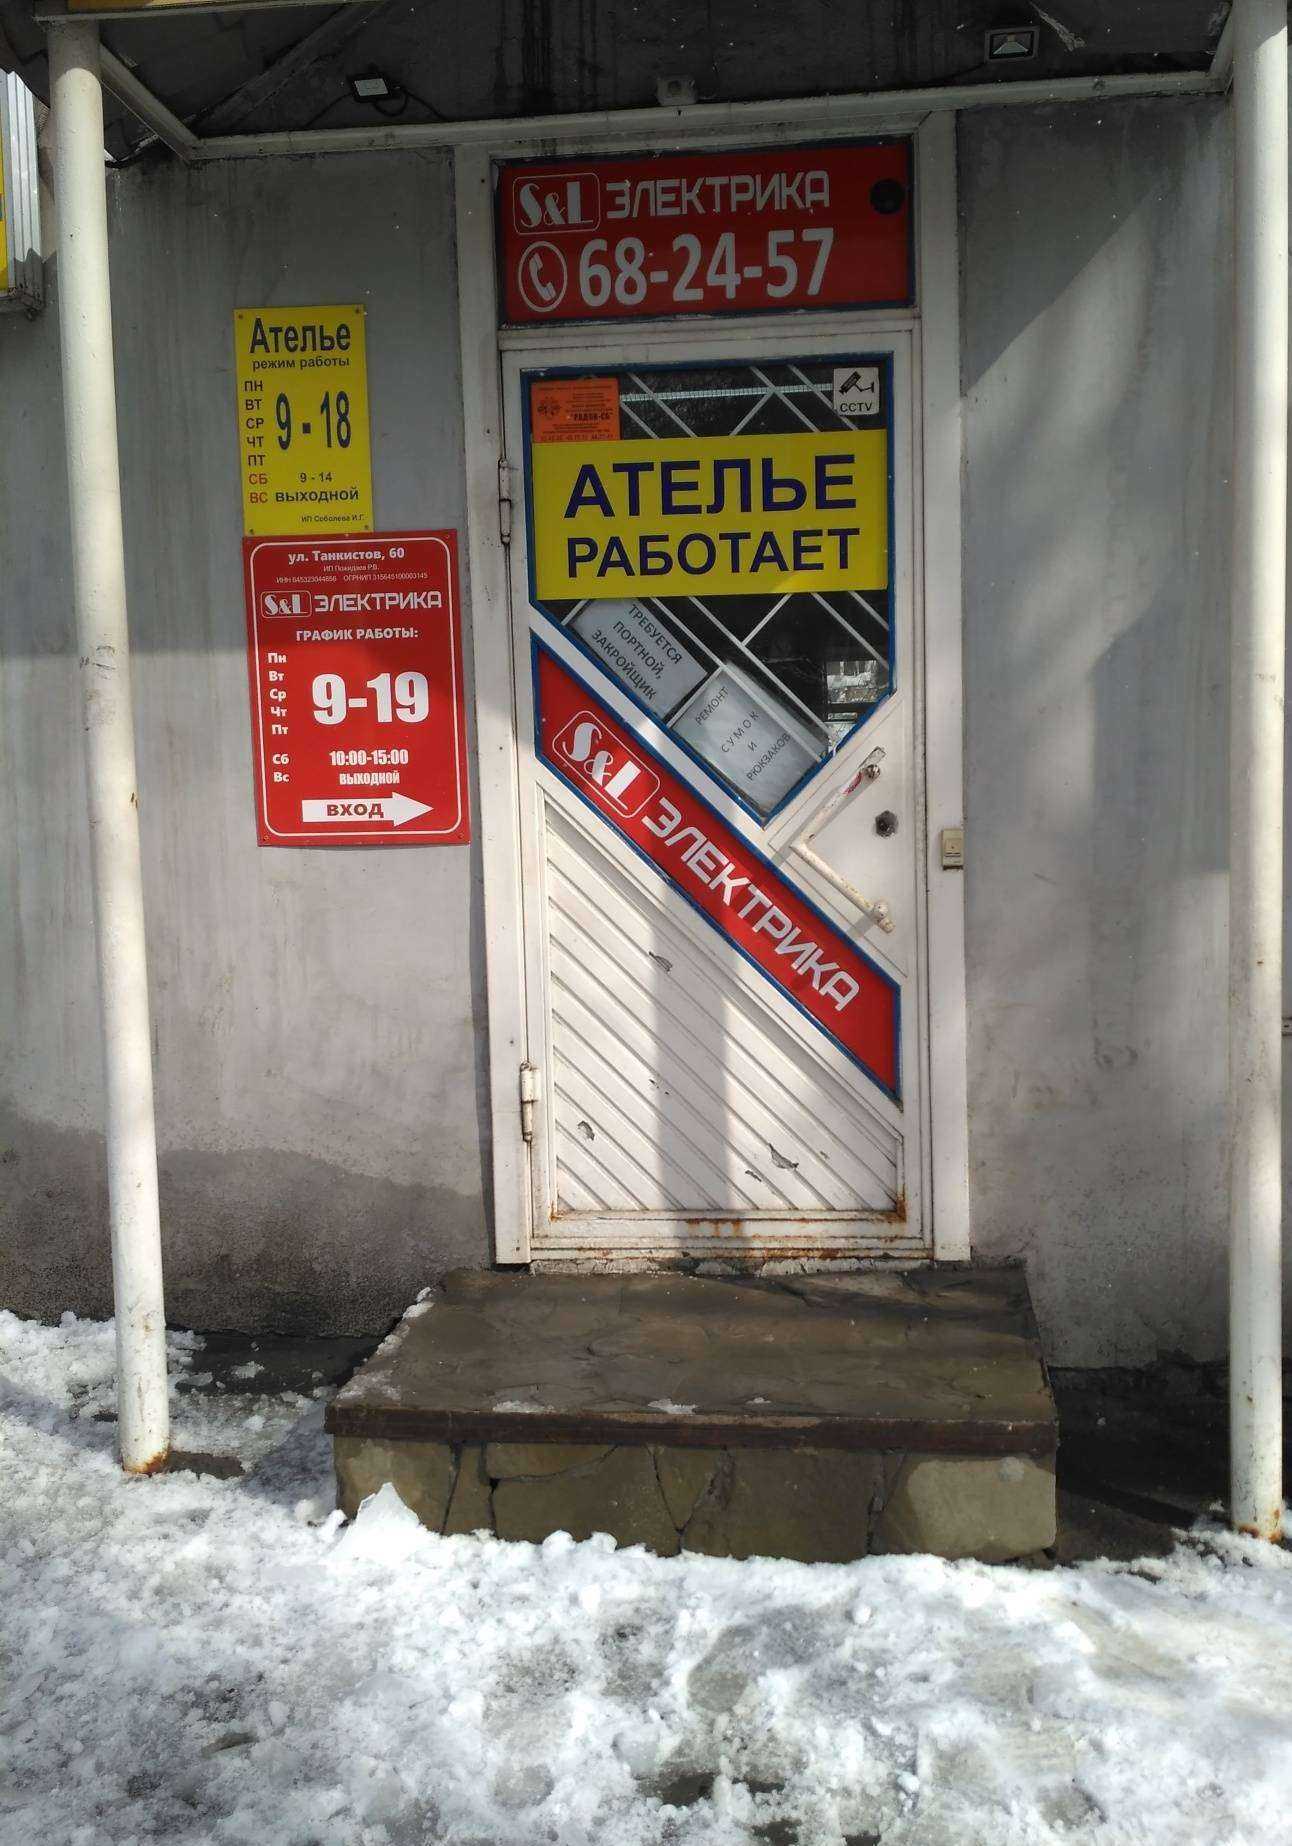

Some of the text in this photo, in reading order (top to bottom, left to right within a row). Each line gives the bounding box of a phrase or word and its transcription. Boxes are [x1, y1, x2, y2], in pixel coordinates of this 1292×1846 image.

[605, 170, 831, 219] ЭЛЕКТРИКА
[578, 227, 834, 307] 68-24-57
[250, 317, 351, 354] Ателье
[252, 356, 349, 371] режим работы
[244, 381, 263, 392] ПН
[245, 399, 262, 410] ВТ
[840, 401, 872, 413] CCTV
[246, 418, 264, 429] СР
[247, 436, 264, 448] ЧТ
[248, 455, 265, 466] ПТ
[249, 473, 268, 485] СБ
[563, 454, 857, 519] АТЕЛЬЕ
[250, 492, 268, 504] ВС
[288, 547, 405, 565] ул. Танкистов, 60
[566, 527, 860, 579] РАБОТАЕТ
[314, 591, 442, 612] ЭЛЕКТРИКА
[296, 627, 419, 642] ГРАФИК РАБОТЫ:
[628, 604, 682, 664] ТРЕБУЕТСЯ
[613, 620, 665, 679] ПОРТНОЙ,
[268, 653, 287, 664] Пн
[591, 630, 656, 700] ЗАКРОЙЩИК
[269, 671, 284, 682] Вт
[269, 689, 287, 701] Ср
[311, 671, 429, 725] 9-19
[270, 707, 287, 717] Чт
[695, 686, 729, 725] РЕМОНТ
[271, 724, 288, 735] Пт
[747, 740, 758, 752] И
[272, 749, 409, 766] Сб 10:00-15:00
[746, 732, 791, 781] РЮКЗАКОВ
[273, 771, 290, 783] Вс
[326, 803, 384, 819] ВХОД
[641, 796, 860, 1012] ЭЛЕКТРИКА
